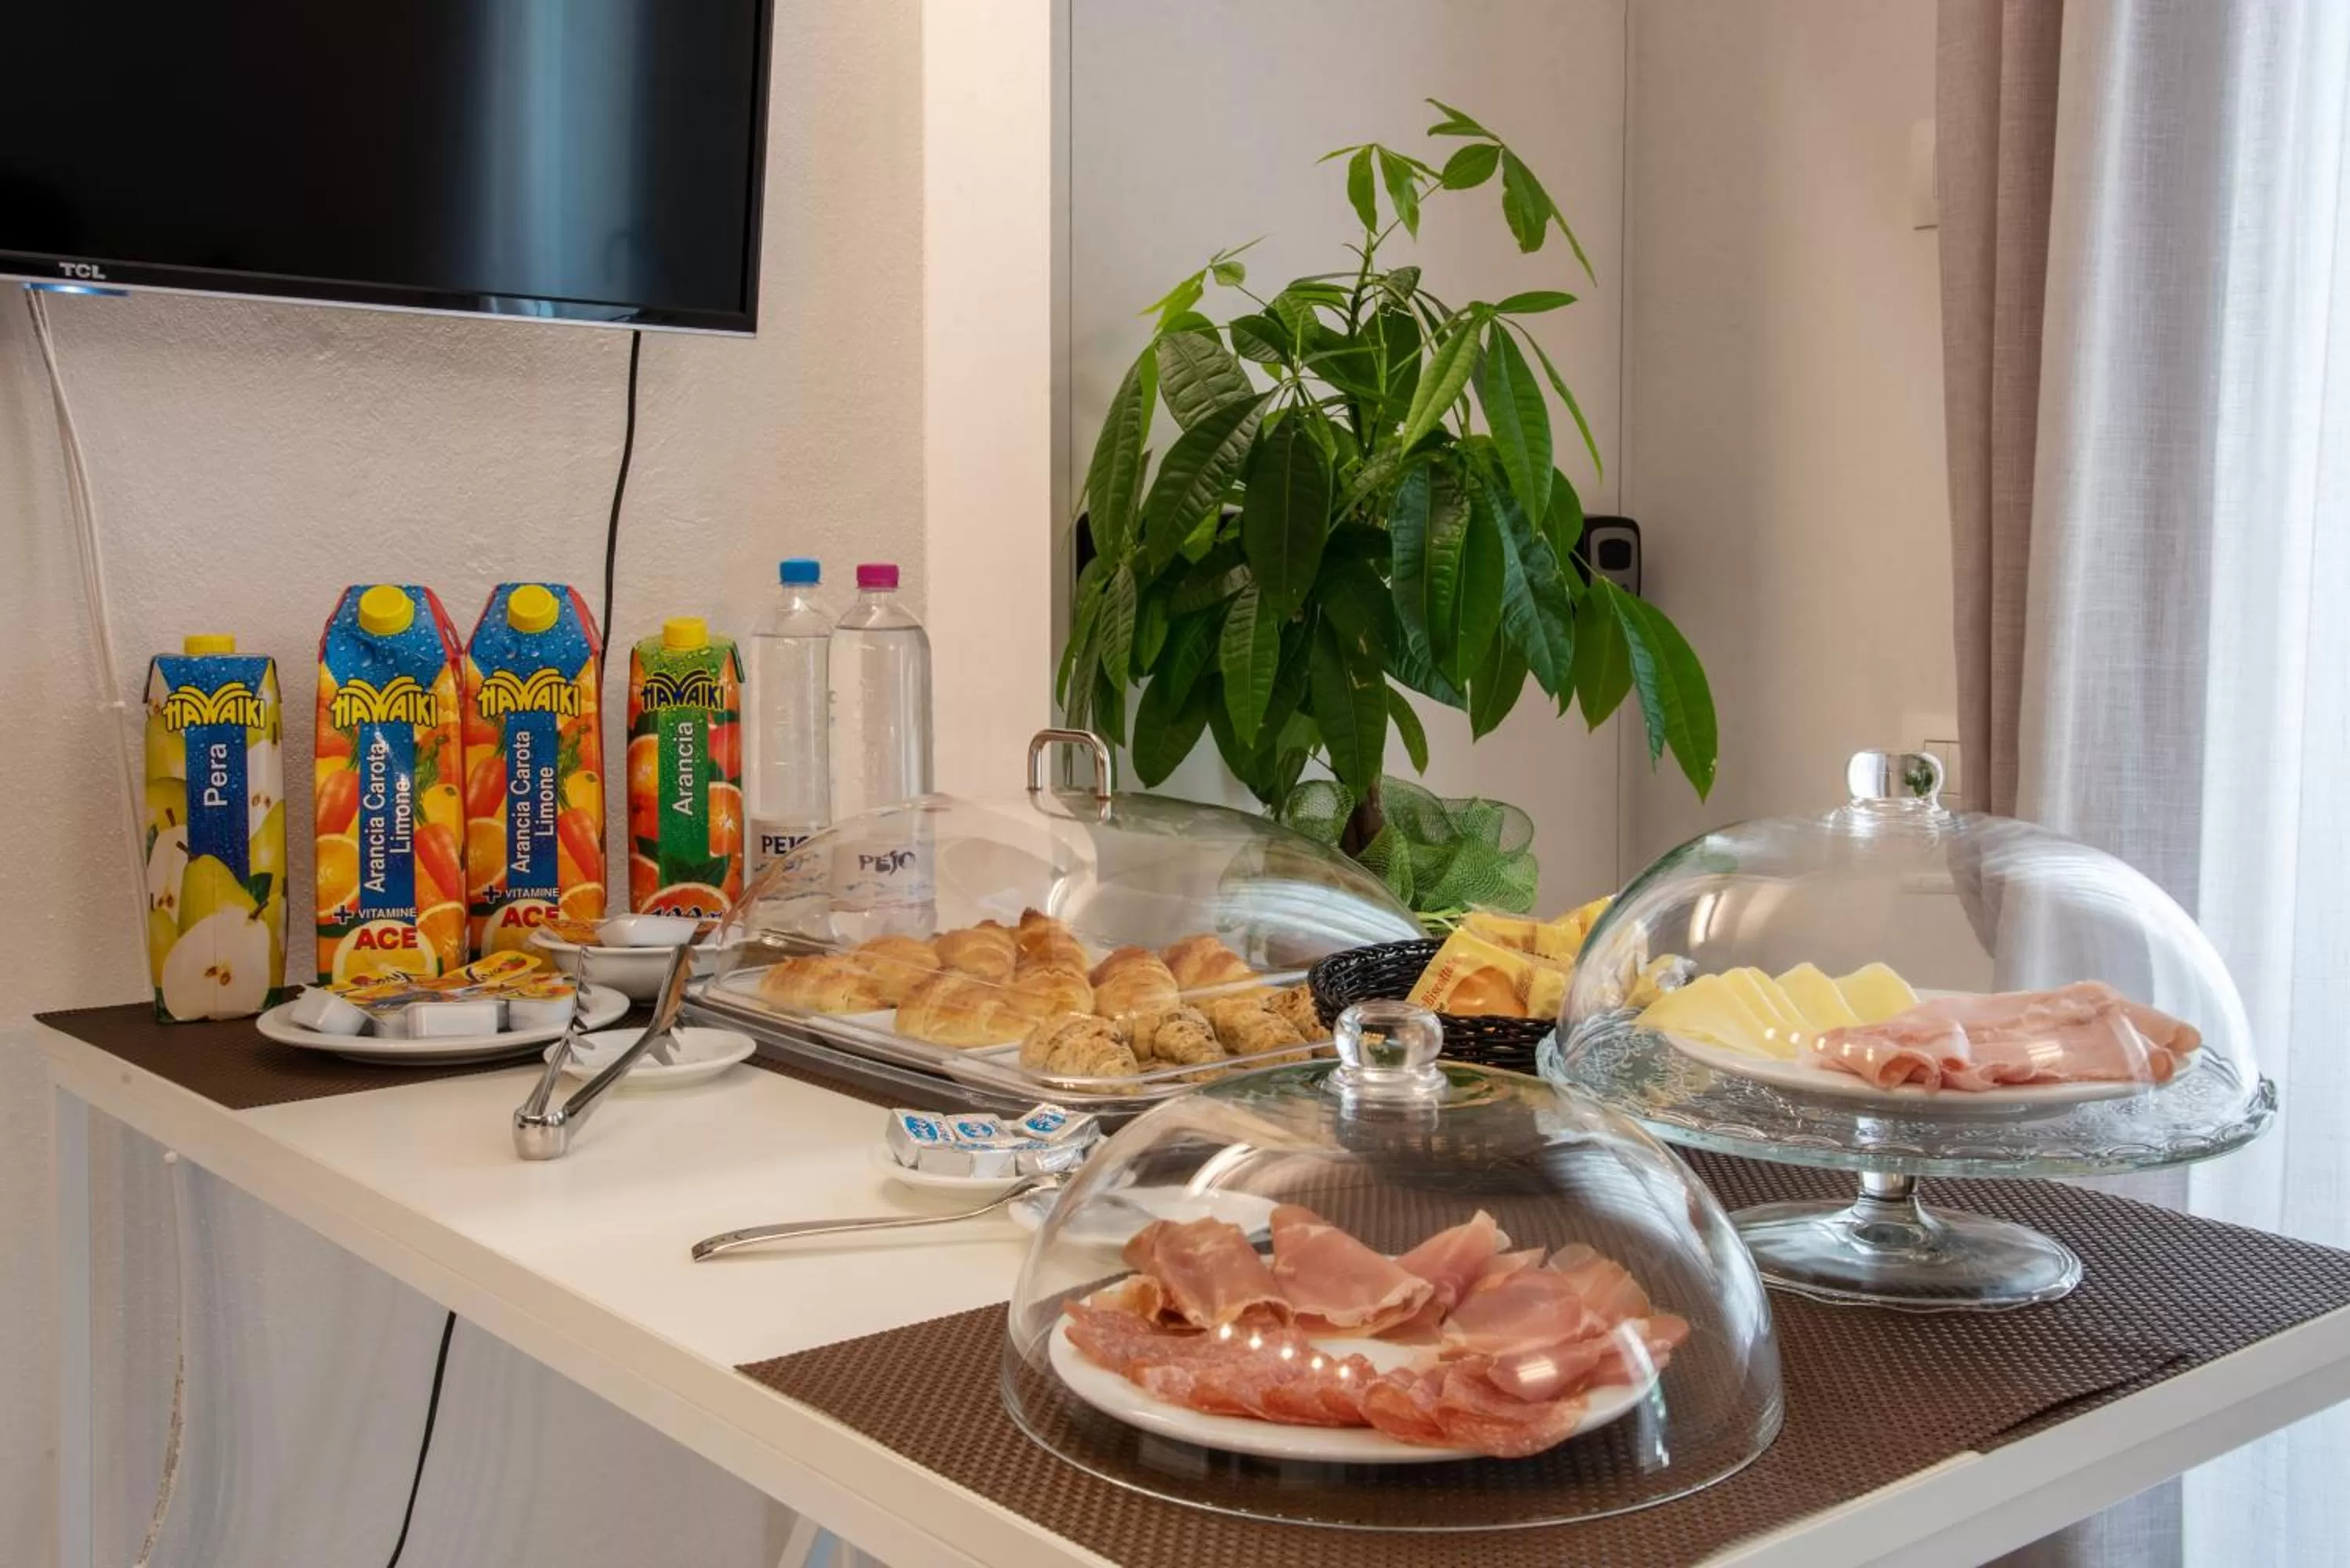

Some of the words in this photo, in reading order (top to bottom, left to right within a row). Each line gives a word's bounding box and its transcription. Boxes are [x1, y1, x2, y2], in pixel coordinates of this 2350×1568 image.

[59, 262, 107, 280] TCL
[162, 680, 266, 731] HAWAIKI
[331, 677, 437, 730] HAWAIKI
[478, 668, 580, 718] HAWAIKI
[642, 670, 725, 713] HAWAIKI
[204, 742, 228, 807] Pera
[363, 741, 386, 811] Carota
[511, 731, 530, 793] Carota
[672, 721, 693, 816] Arancia
[390, 778, 411, 853] Limone
[535, 766, 555, 836] Limone
[363, 817, 385, 893] Arancia
[511, 800, 530, 873] Arancia
[357, 907, 418, 919] VITAMINE
[505, 887, 560, 898] VITAMINE
[354, 927, 419, 950] ACE
